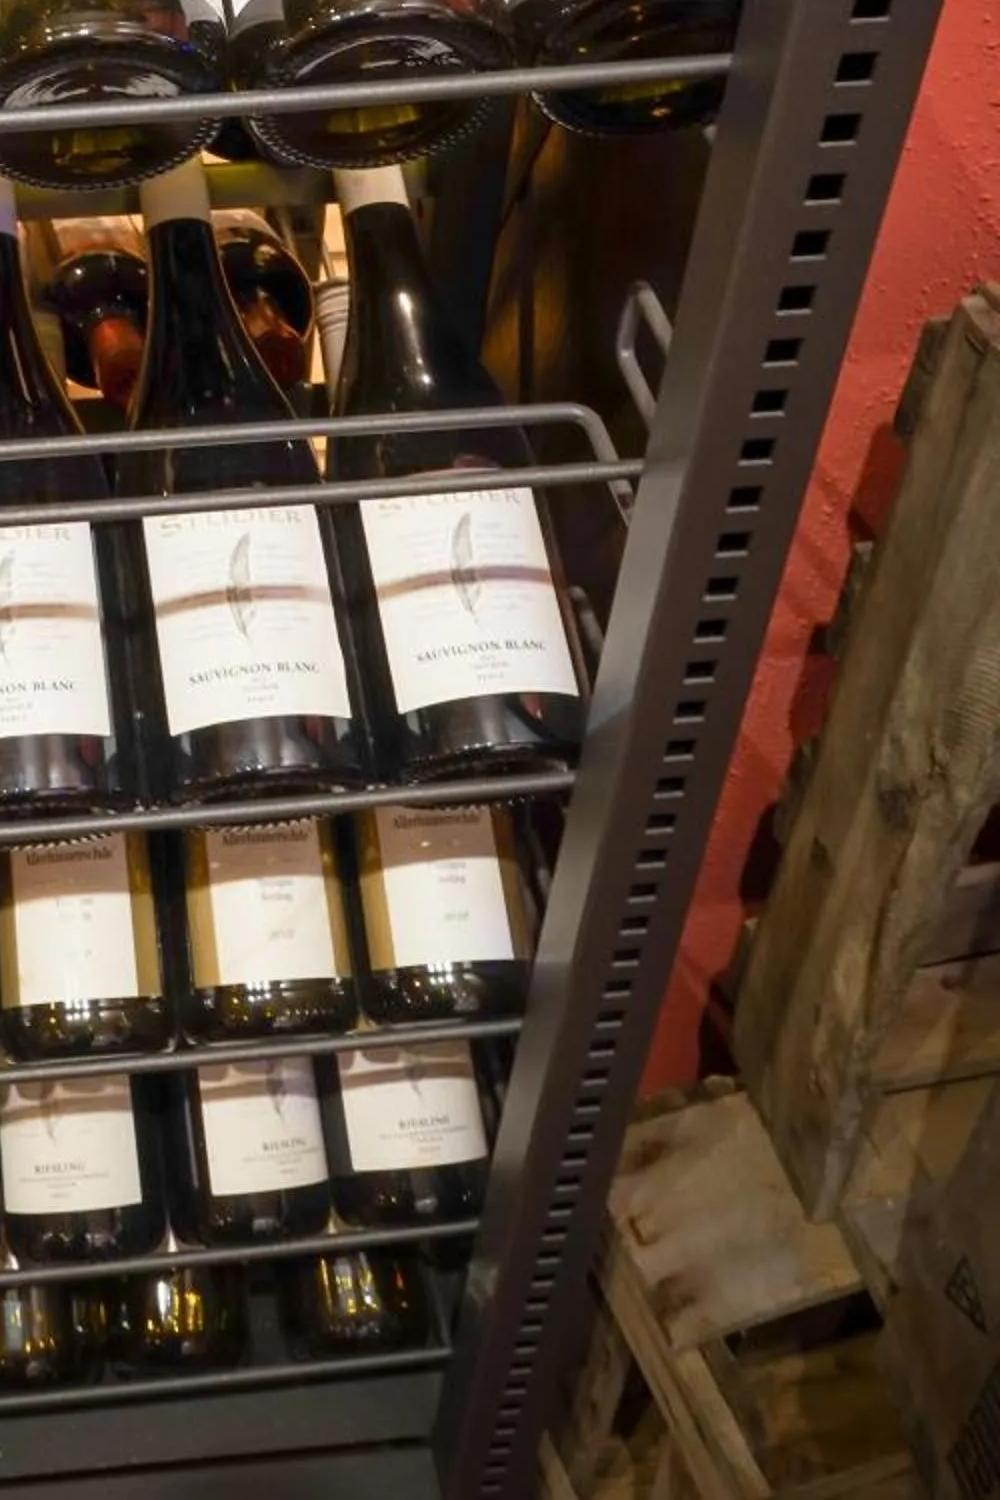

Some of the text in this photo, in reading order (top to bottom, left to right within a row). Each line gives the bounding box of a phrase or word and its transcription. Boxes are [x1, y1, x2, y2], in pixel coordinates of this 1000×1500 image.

[417, 638, 547, 663] SAUVIGNON BLANC
[188, 660, 320, 686] SAUVIGNON BLANC
[32, 680, 74, 693] BLANC
